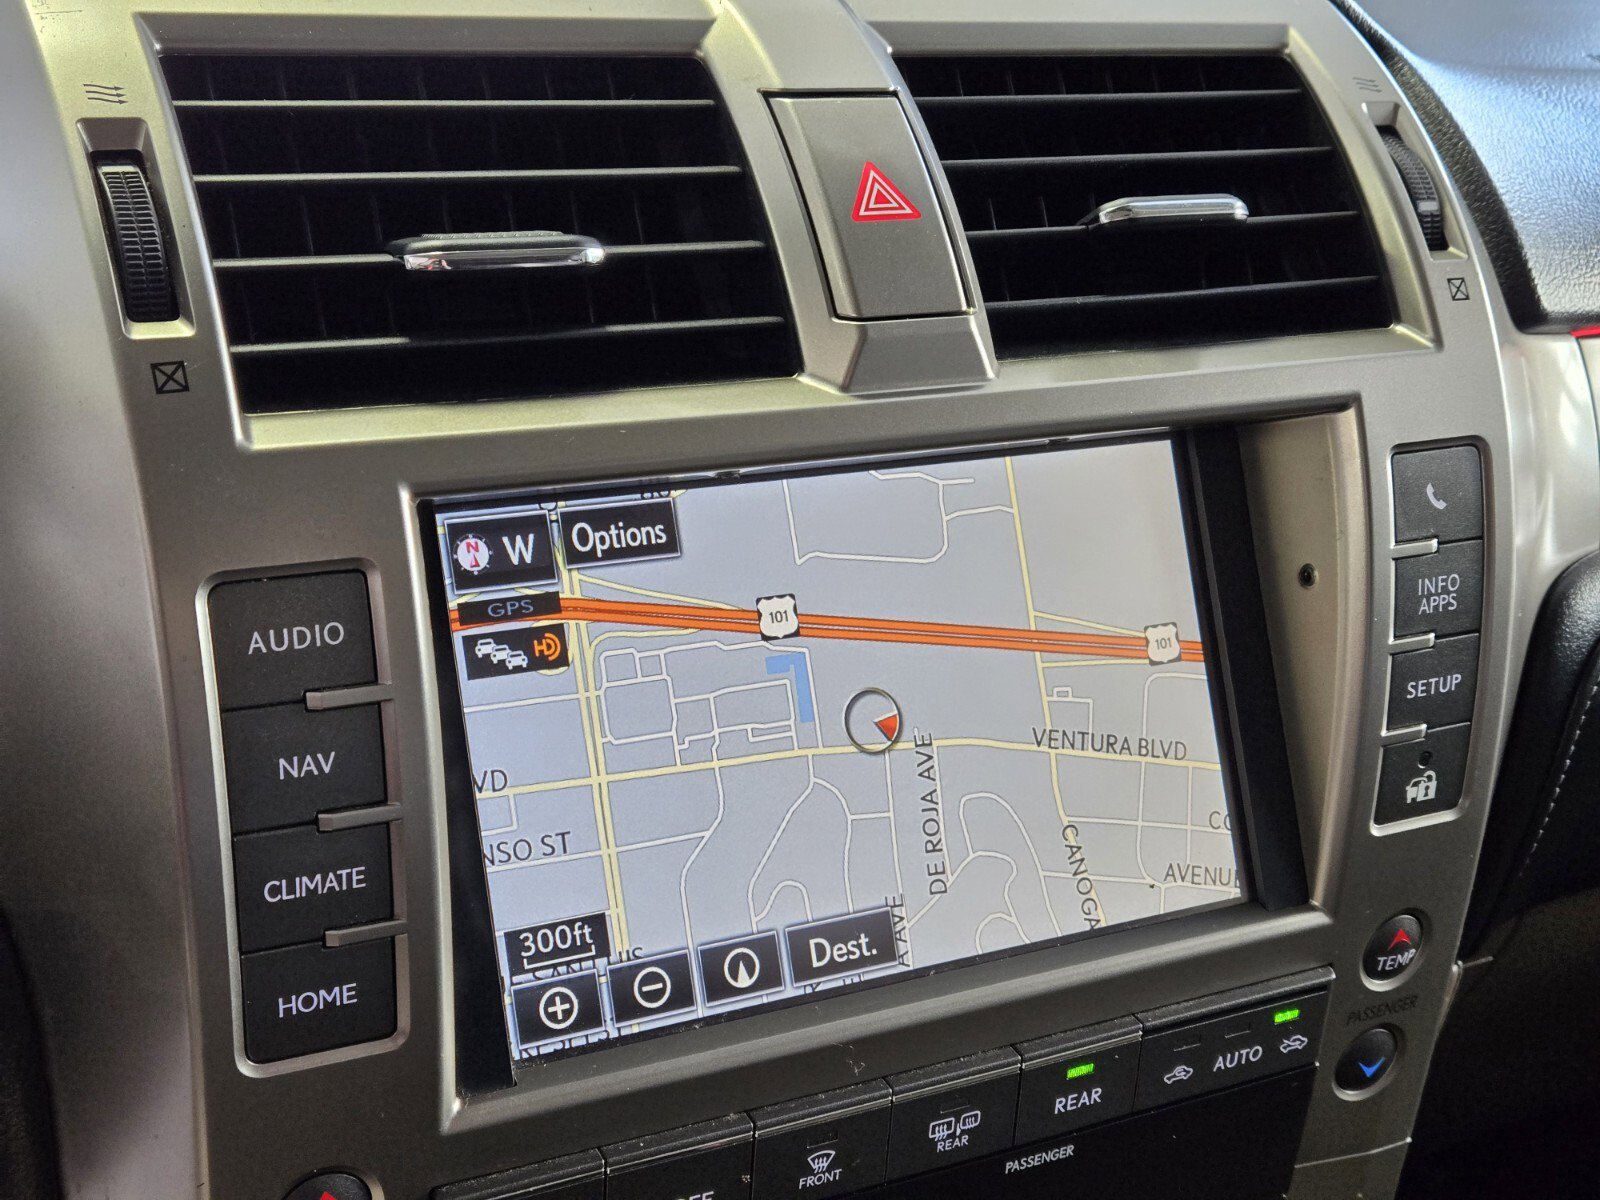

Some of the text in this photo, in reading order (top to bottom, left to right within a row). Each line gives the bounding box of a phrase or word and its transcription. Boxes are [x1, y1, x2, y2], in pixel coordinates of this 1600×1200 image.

[465, 541, 479, 553] N
[502, 533, 535, 566] W
[571, 521, 668, 558] Options
[1417, 573, 1461, 596] INFO
[487, 599, 535, 618] GPS
[769, 609, 789, 624] 101
[1418, 593, 1458, 616] APPS
[247, 620, 346, 656] AUDIO
[1154, 636, 1173, 651] 101
[1406, 673, 1463, 699] SETUP
[1031, 726, 1187, 762] VENTURA BLVD
[278, 751, 336, 781] NAV
[913, 732, 949, 896] DE ROJA AVE
[540, 831, 571, 857] ST
[263, 866, 367, 904] CLIMATE
[1061, 823, 1101, 931] CANOGA
[519, 921, 595, 957] 300ft
[808, 932, 879, 969] Dest.
[1376, 948, 1417, 972] TEMP
[277, 982, 358, 1019] HOME
[1212, 1045, 1264, 1072] AUTO
[1054, 1087, 1103, 1115] REAR
[936, 1135, 969, 1153] REAR
[1004, 1144, 1076, 1175] PASSENGER
[798, 1168, 843, 1190] FRONT
